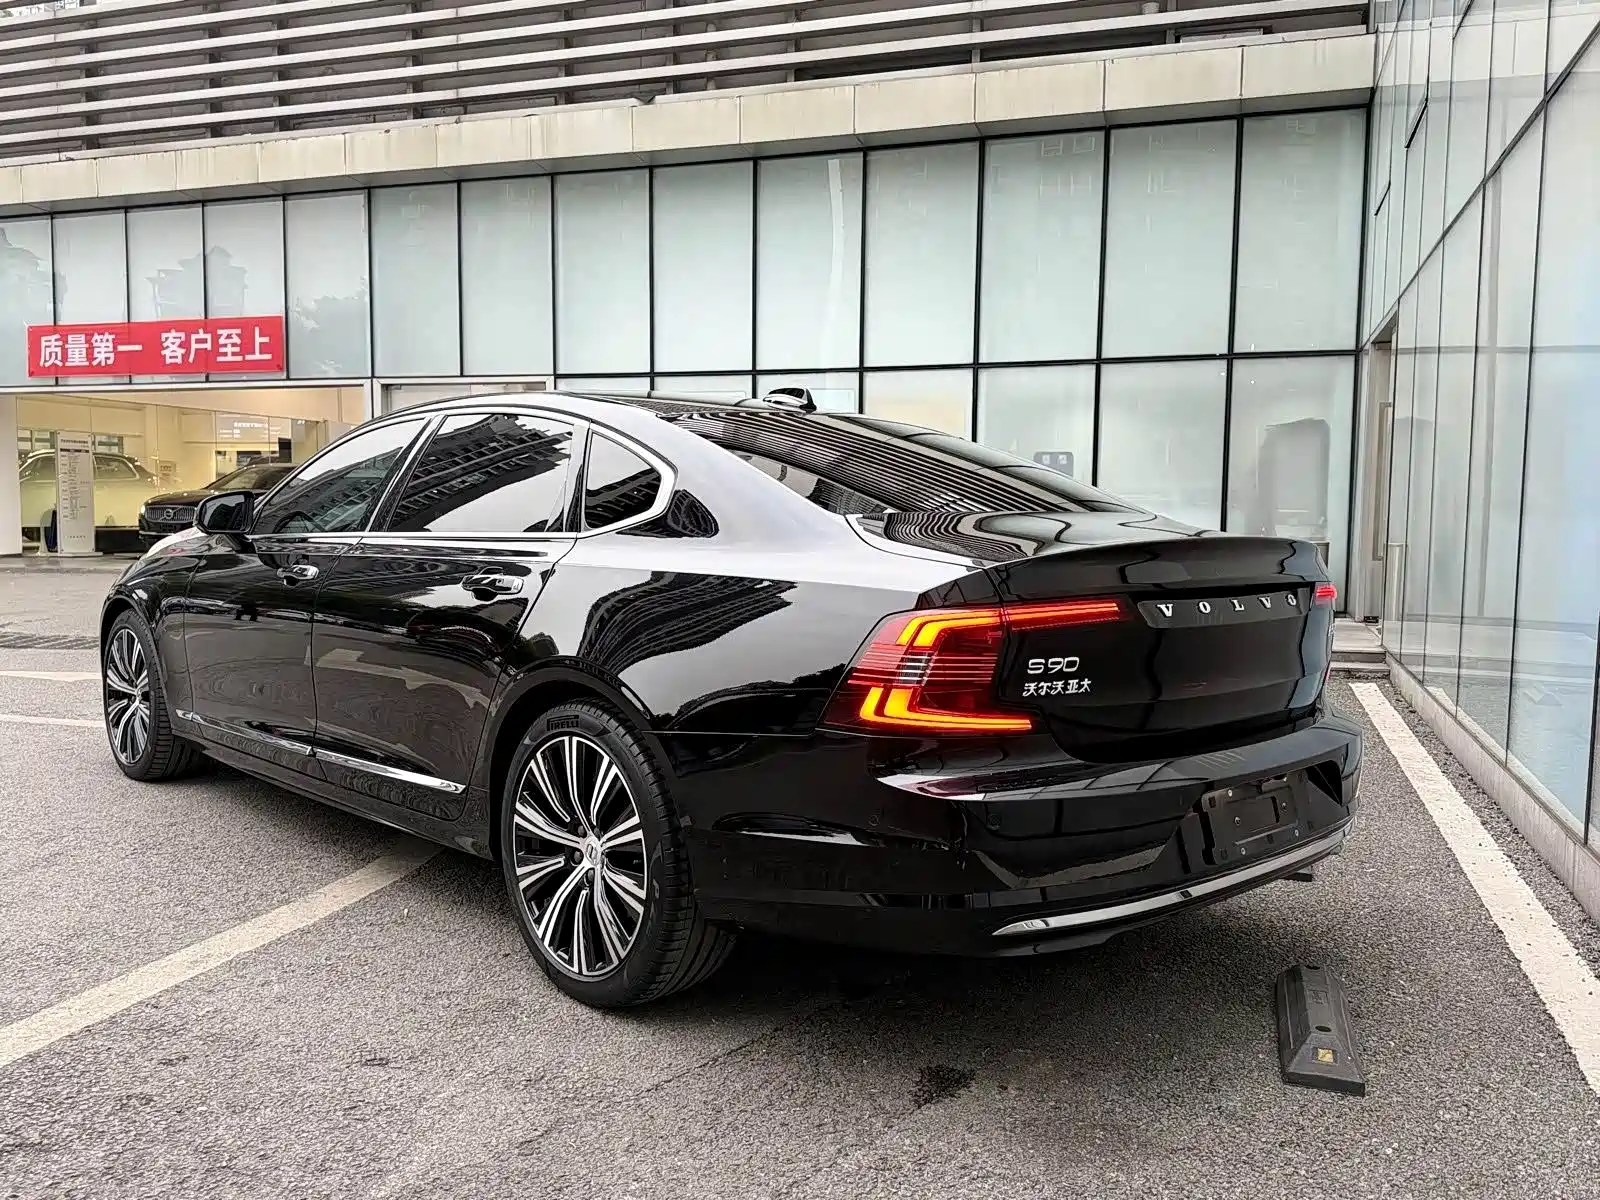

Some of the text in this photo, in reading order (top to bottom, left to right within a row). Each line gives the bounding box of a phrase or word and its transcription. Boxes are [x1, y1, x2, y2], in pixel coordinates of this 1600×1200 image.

[39, 326, 273, 368] 质量第一 客户至上
[1157, 594, 1297, 617] VOLVO
[1026, 656, 1080, 675] S90
[1022, 678, 1092, 697] 沃尔沃亚太
[547, 715, 579, 731] PIRELLI
